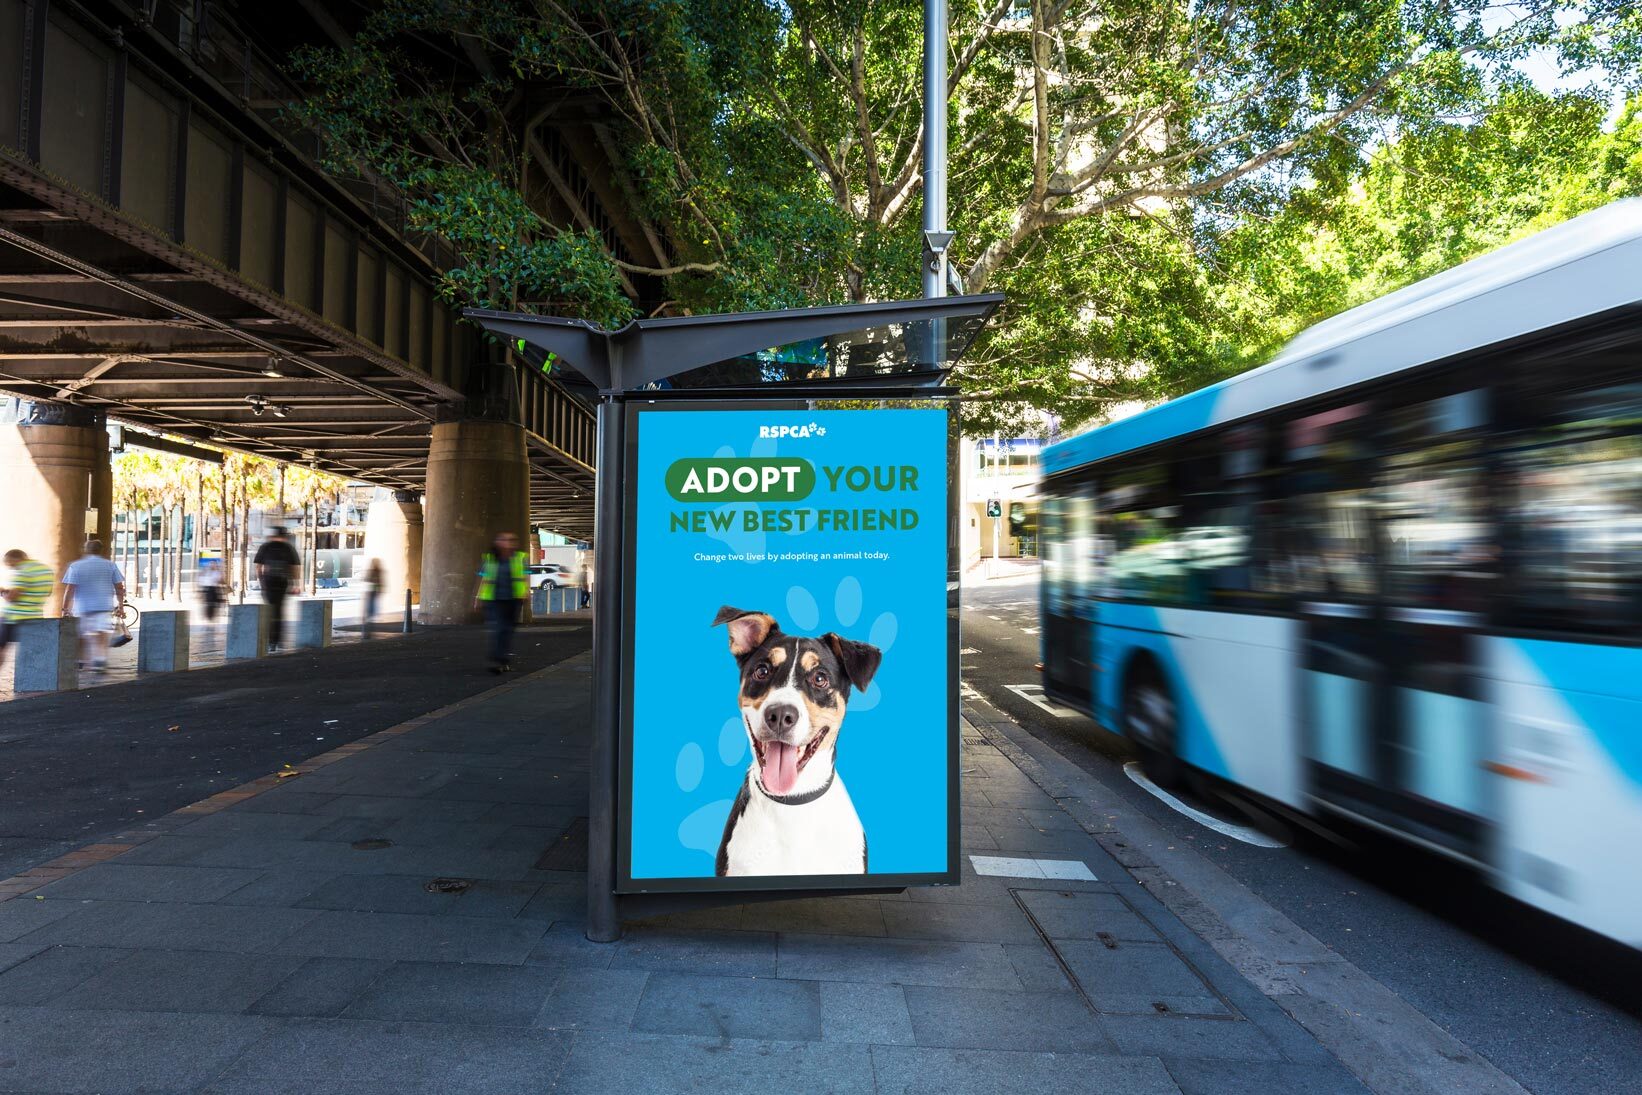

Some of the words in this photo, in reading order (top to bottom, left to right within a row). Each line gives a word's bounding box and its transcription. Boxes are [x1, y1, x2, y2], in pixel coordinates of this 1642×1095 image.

[759, 424, 810, 439] RSPCA
[680, 466, 801, 494] ADOPT
[822, 465, 920, 492] YOUR
[670, 510, 737, 533] NEW
[743, 509, 811, 532] BEST
[817, 508, 919, 532] FRIEND
[694, 553, 727, 563] Change
[728, 553, 744, 561] two
[746, 552, 766, 561] lives
[767, 552, 779, 562] by
[780, 552, 819, 562] adopting
[832, 551, 862, 560] animal
[864, 551, 890, 561] today.
